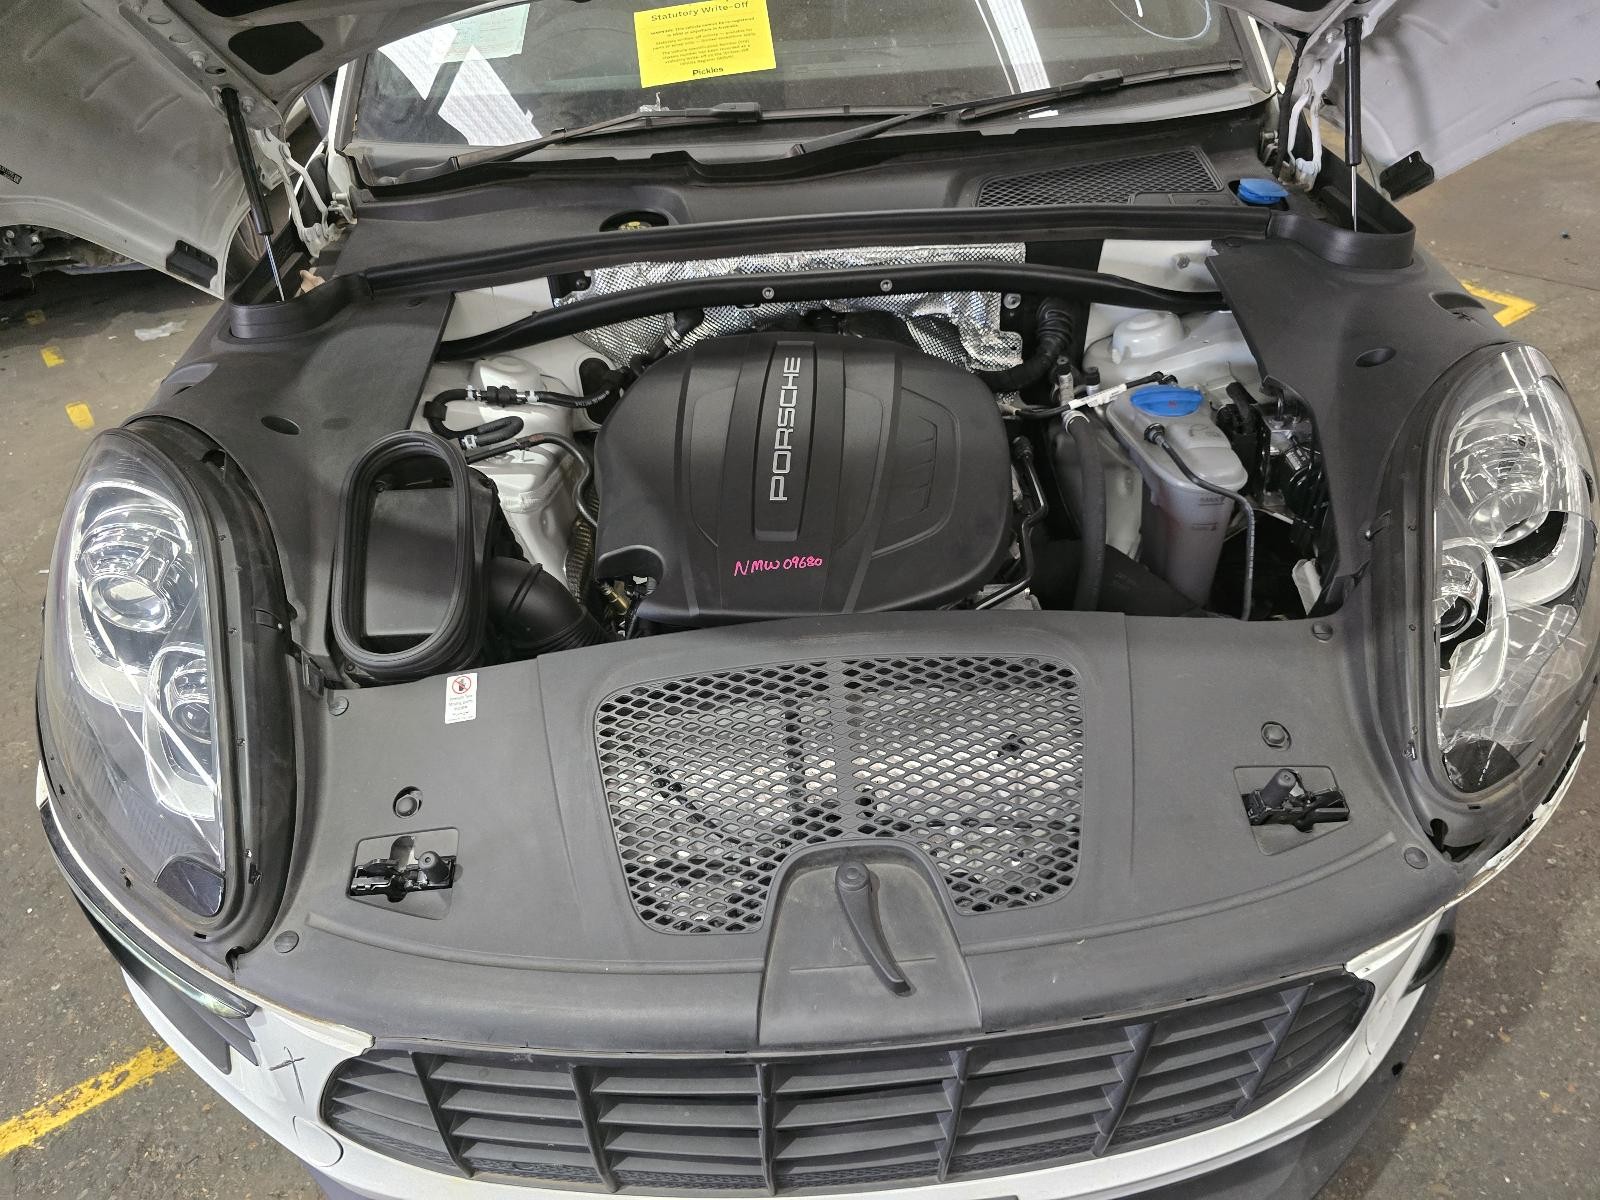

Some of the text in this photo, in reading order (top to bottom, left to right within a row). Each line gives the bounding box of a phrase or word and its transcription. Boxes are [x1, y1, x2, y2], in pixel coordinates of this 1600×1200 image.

[651, 1, 749, 22] Statutory Write-Off
[692, 66, 724, 76] Pickles
[769, 357, 801, 501] PORSCHE
[734, 555, 823, 577] NMW 09680
